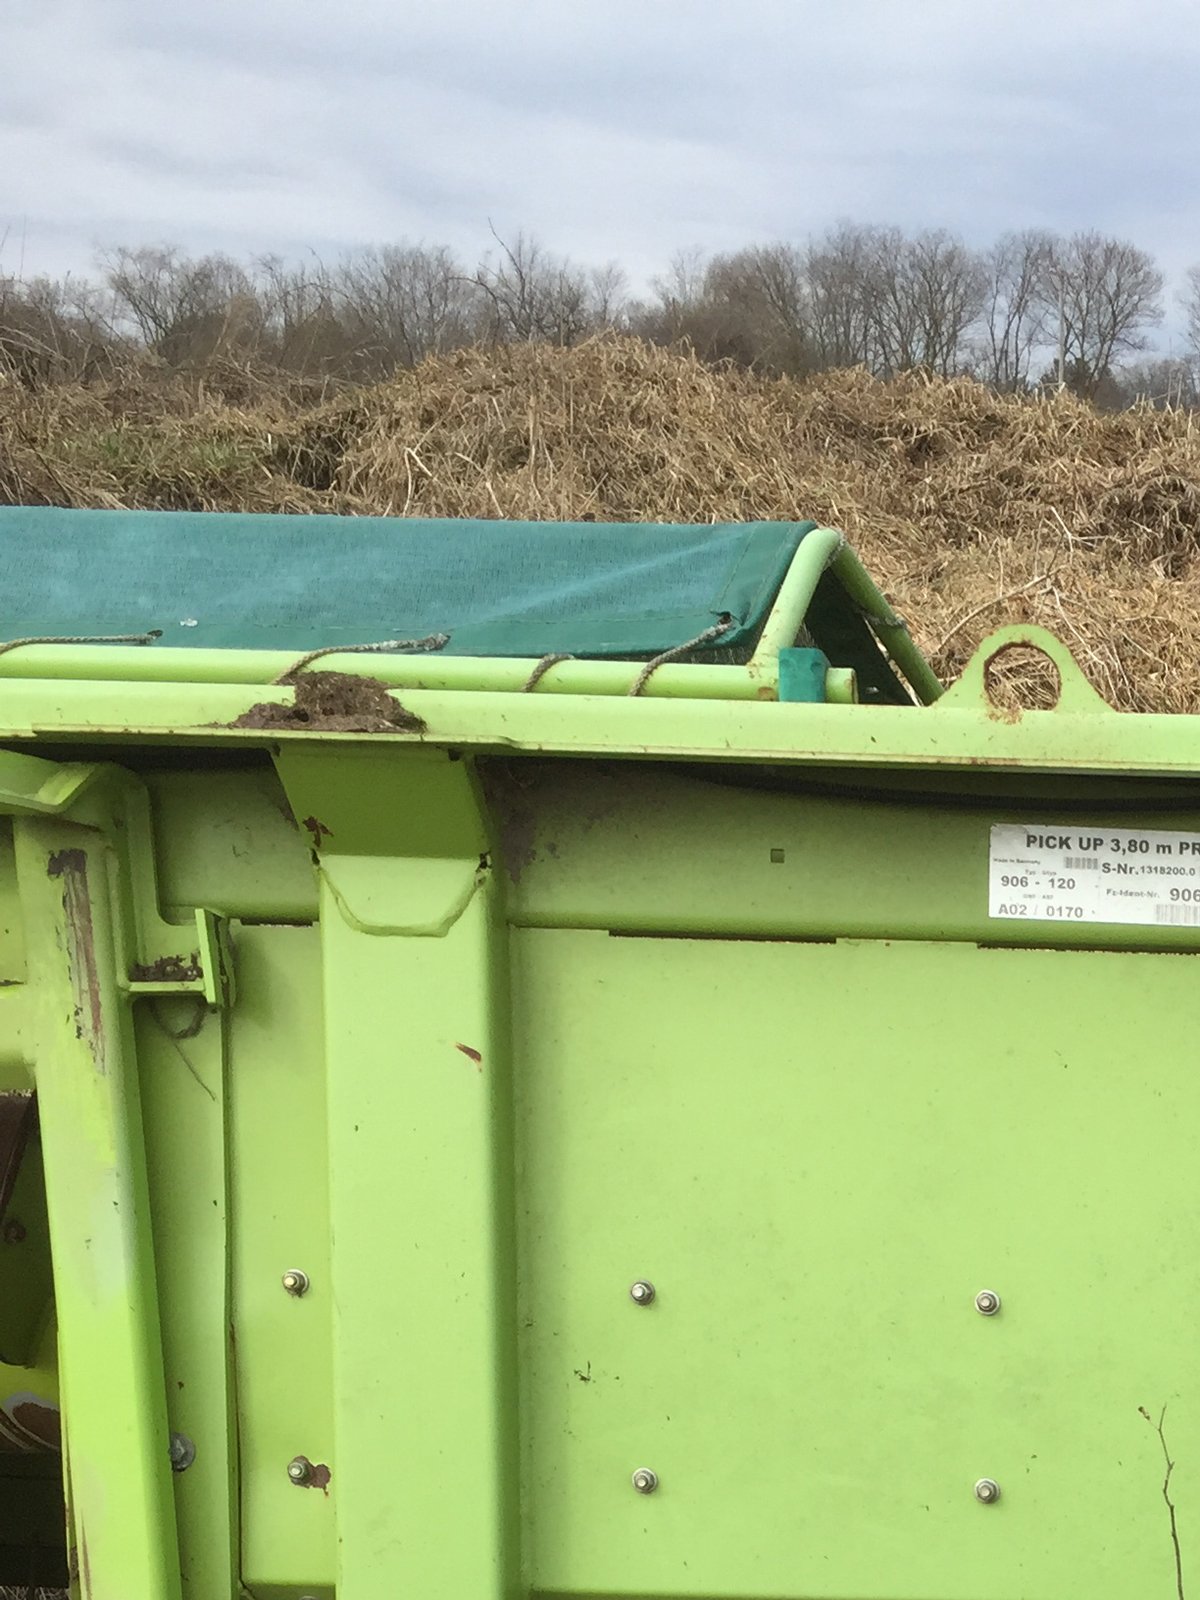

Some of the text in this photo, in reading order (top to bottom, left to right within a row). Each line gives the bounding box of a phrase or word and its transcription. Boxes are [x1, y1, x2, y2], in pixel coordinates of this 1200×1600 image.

[1026, 834, 1072, 850] PICK
[1078, 837, 1104, 851] UP
[1110, 838, 1150, 856] 3,80
[1156, 842, 1172, 855] m
[1000, 875, 1029, 888] 906
[1047, 877, 1076, 890] 120
[998, 903, 1028, 916] A02
[1046, 905, 1084, 919] 0170
